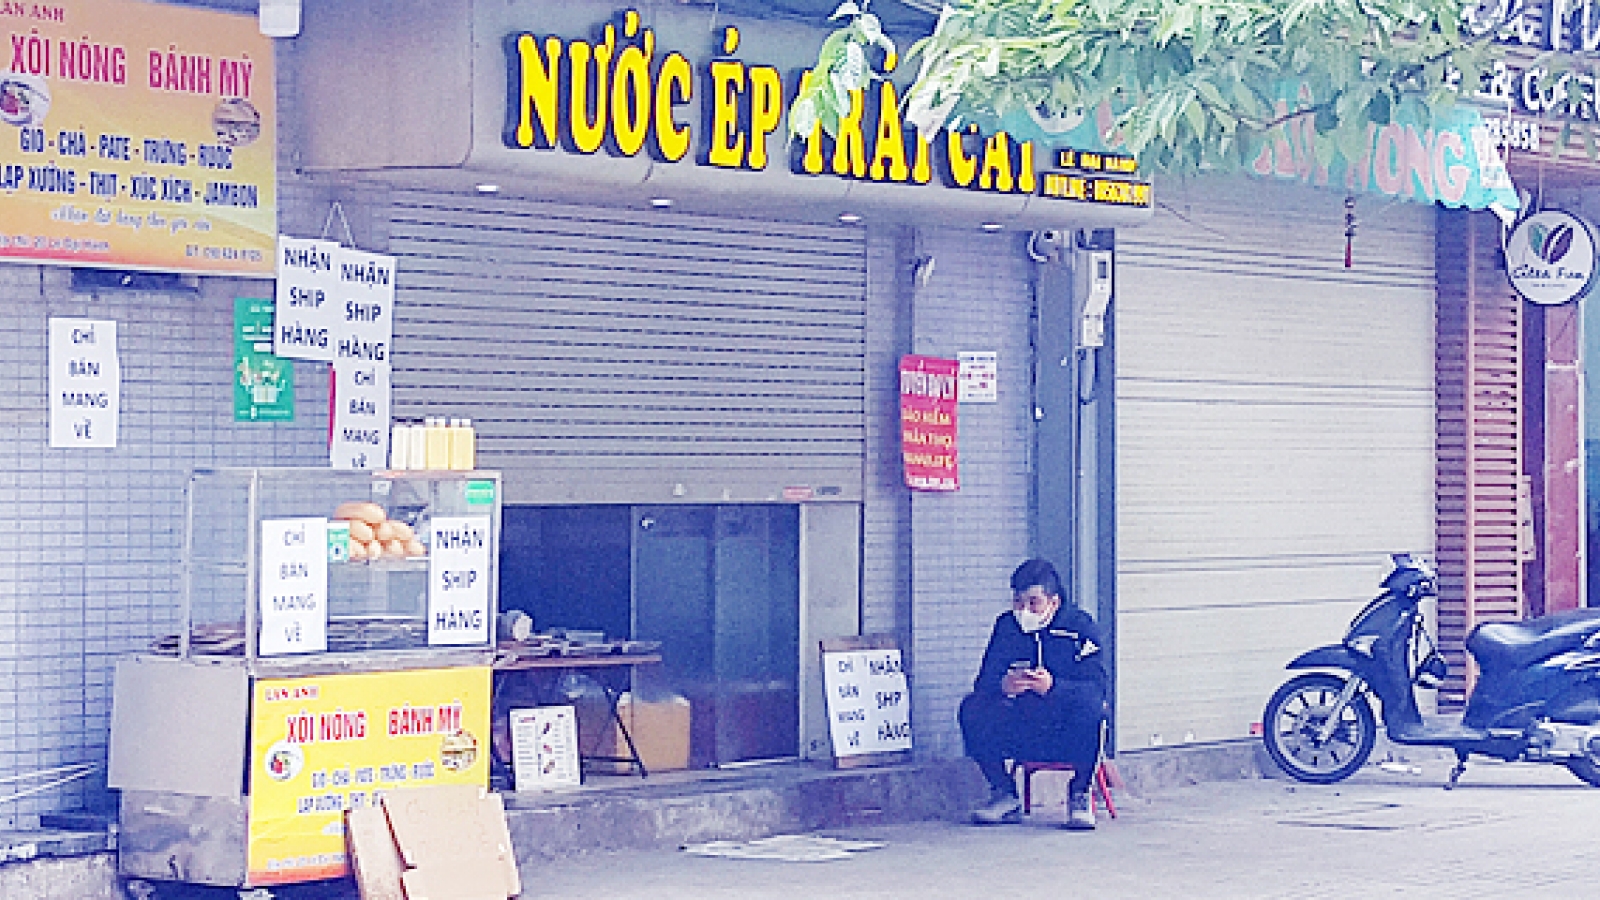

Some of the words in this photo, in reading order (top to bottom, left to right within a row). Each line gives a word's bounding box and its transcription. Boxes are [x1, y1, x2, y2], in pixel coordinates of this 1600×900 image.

[29, 4, 64, 23] ANH
[11, 28, 50, 77] XÔI
[59, 35, 126, 85] NÓNG
[149, 45, 211, 94] BÁNH
[219, 53, 253, 98] MỲ
[516, 10, 692, 162] NƯỚC
[708, 26, 782, 172] ÉP
[99, 134, 130, 161] PATE
[90, 171, 117, 202] THỊT
[284, 246, 331, 273] NHẬN
[341, 261, 390, 289] NHẬN
[290, 286, 325, 308] SHIP
[345, 301, 382, 322] SHIP
[70, 323, 96, 344] CHỈ
[281, 321, 328, 348] HÀNG
[338, 334, 384, 361] HÀNG
[354, 366, 376, 386] CHỈ
[62, 391, 109, 409] MANG
[284, 523, 306, 547] CHỈ
[436, 522, 485, 555] NHẬN
[441, 570, 477, 592] SHIP
[272, 592, 317, 611] MANG
[433, 605, 484, 631] HÀNG
[286, 708, 314, 744] XÔI
[319, 706, 366, 739] NÓNG
[388, 702, 435, 736] BÁNH
